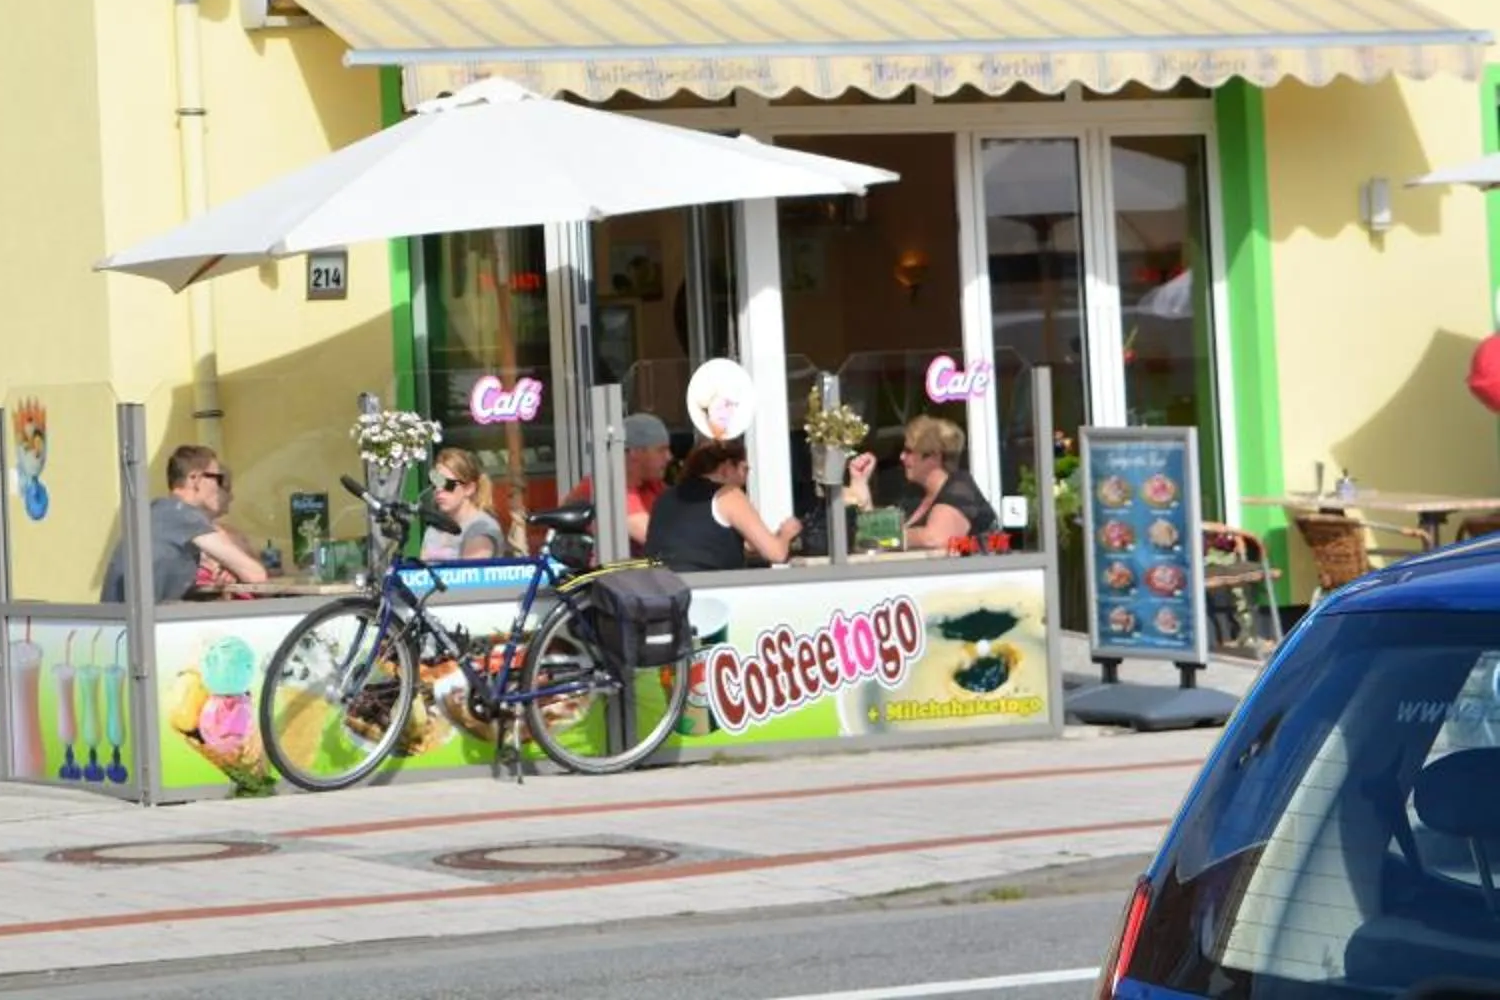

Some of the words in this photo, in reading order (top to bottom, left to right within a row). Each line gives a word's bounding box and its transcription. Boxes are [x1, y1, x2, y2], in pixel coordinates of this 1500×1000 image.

[312, 267, 341, 288] 214
[470, 375, 542, 424] Café
[925, 355, 990, 403] Café
